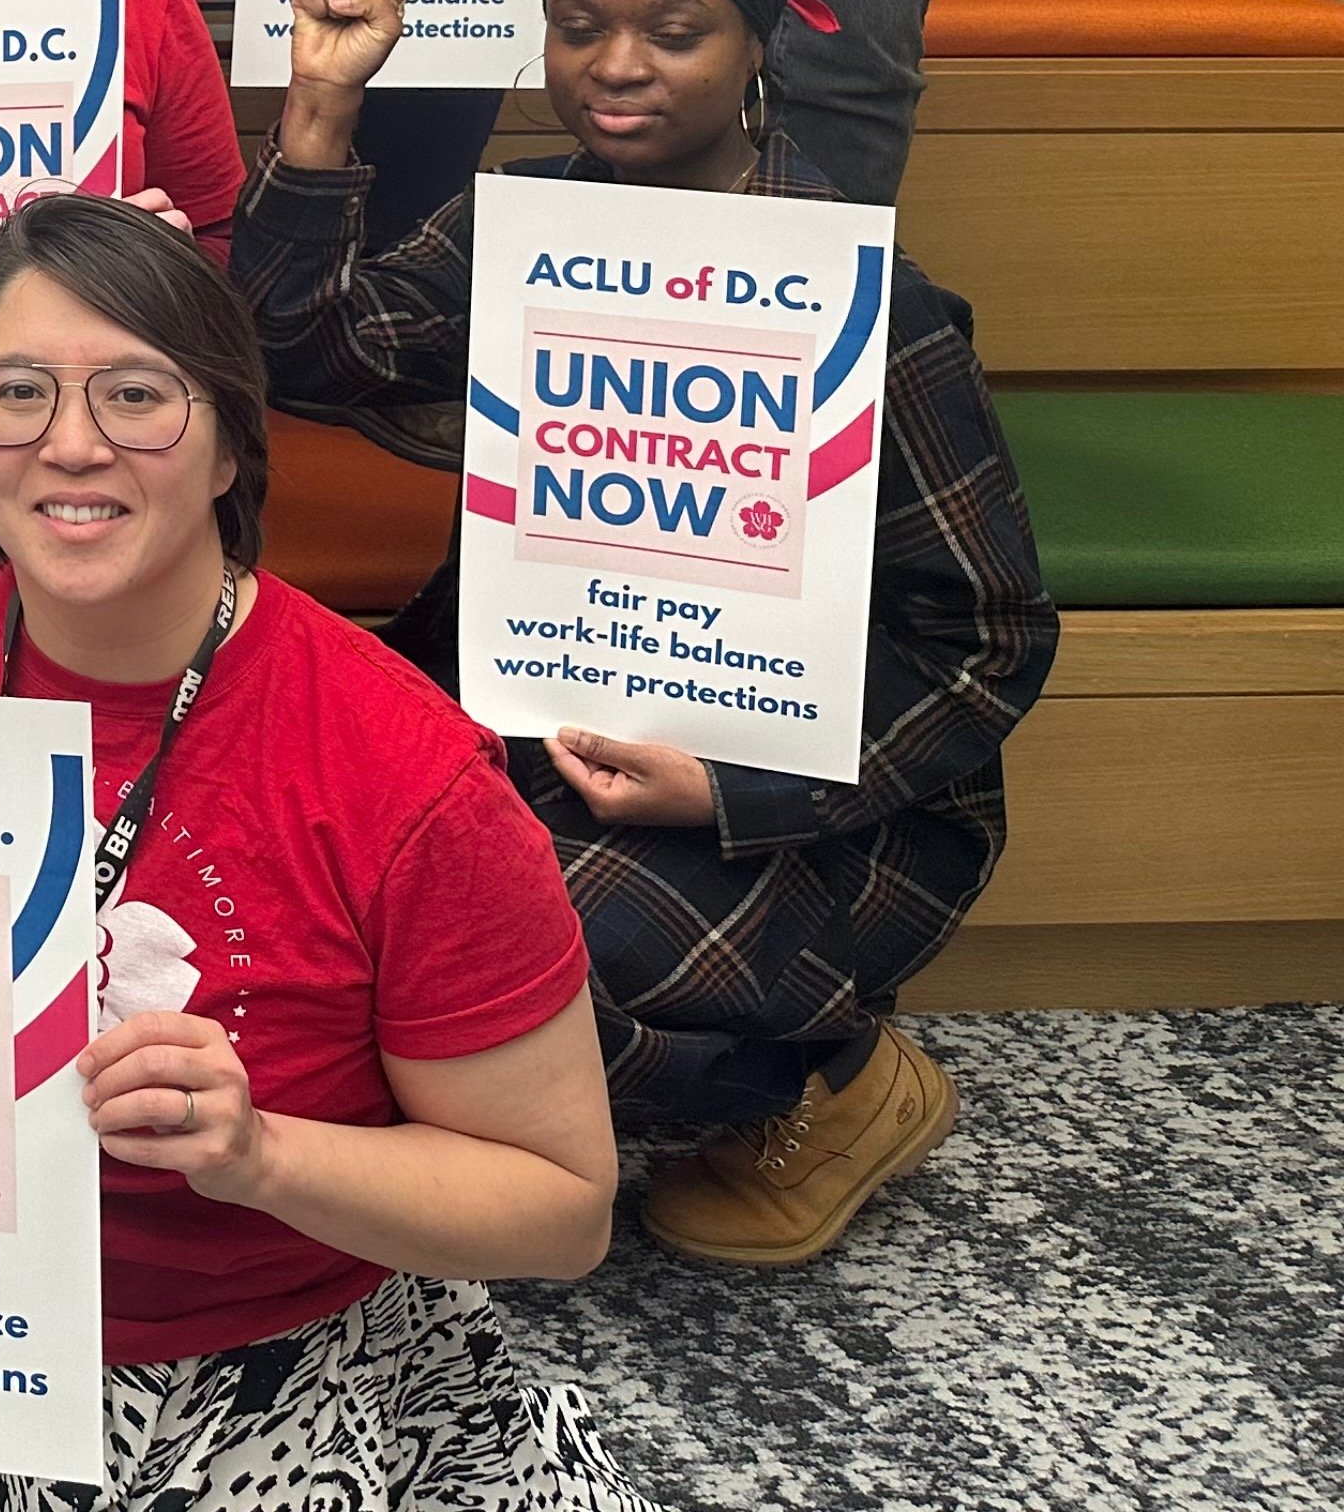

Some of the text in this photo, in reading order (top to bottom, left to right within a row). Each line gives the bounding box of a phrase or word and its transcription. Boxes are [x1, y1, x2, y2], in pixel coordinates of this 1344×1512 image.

[3, 28, 77, 63] D.C.
[400, 17, 515, 38] otections
[526, 253, 822, 313] ACLU of D.C.
[535, 349, 799, 434] UNION
[536, 421, 791, 481] CONTRACT
[533, 465, 728, 538] NOW
[588, 579, 722, 631] fair pay
[507, 617, 805, 678] work-life balance
[172, 667, 203, 722] ACLU
[494, 654, 818, 721] worker protections
[104, 815, 138, 860] BE
